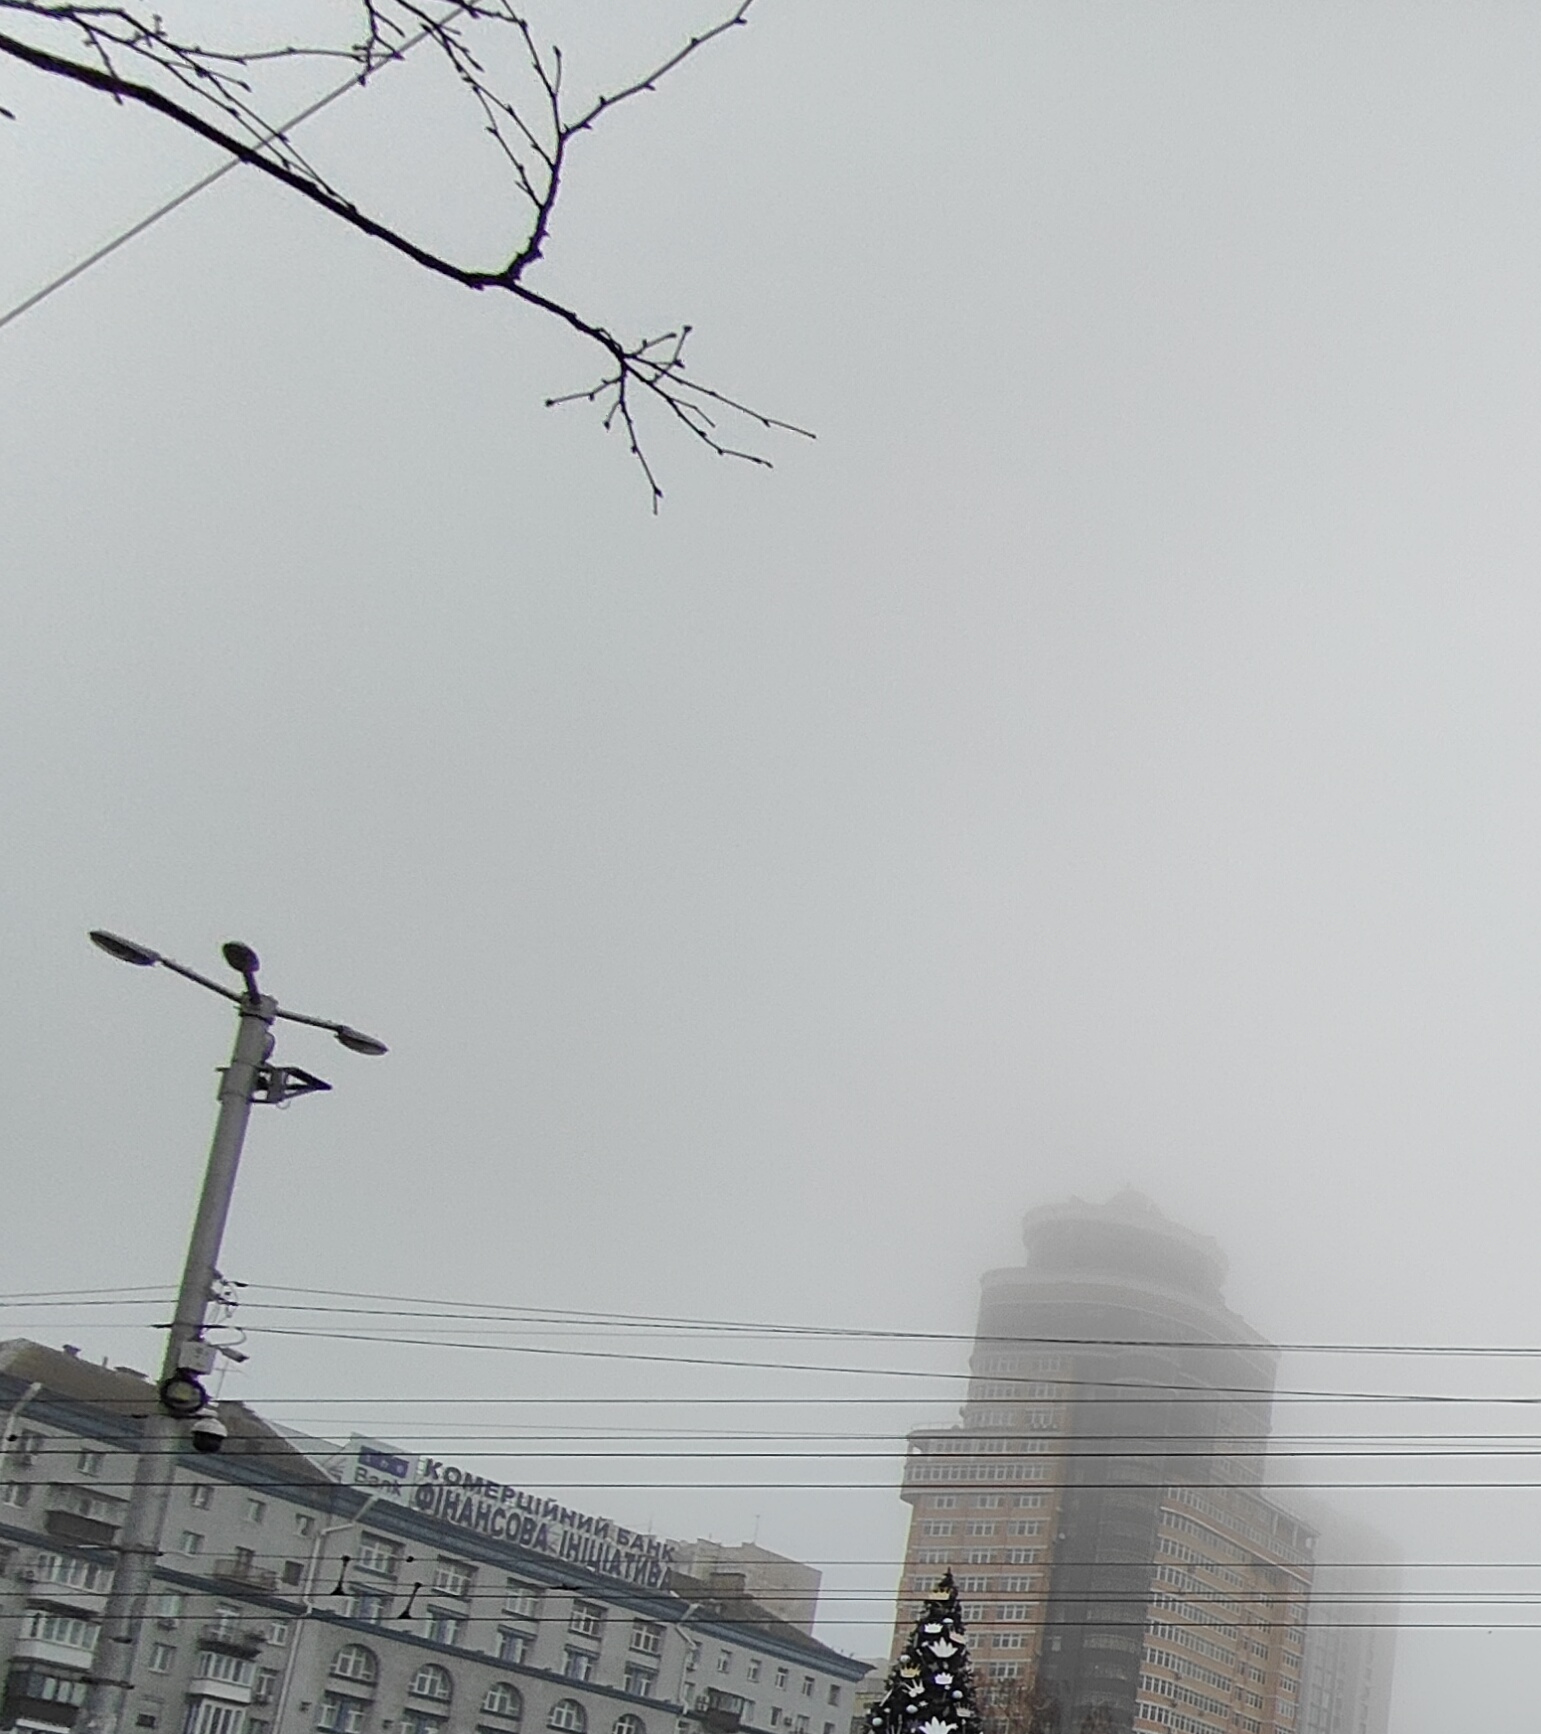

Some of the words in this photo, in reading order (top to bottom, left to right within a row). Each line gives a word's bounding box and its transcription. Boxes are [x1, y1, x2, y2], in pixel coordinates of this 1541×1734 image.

[414, 1483, 550, 1551] ФІНАНСОВА
[558, 1530, 672, 1591] ІНІЦІАТИВА
[423, 1458, 610, 1539] КОМЕРЦІЙНИЙ
[617, 1527, 676, 1562] БАНК
